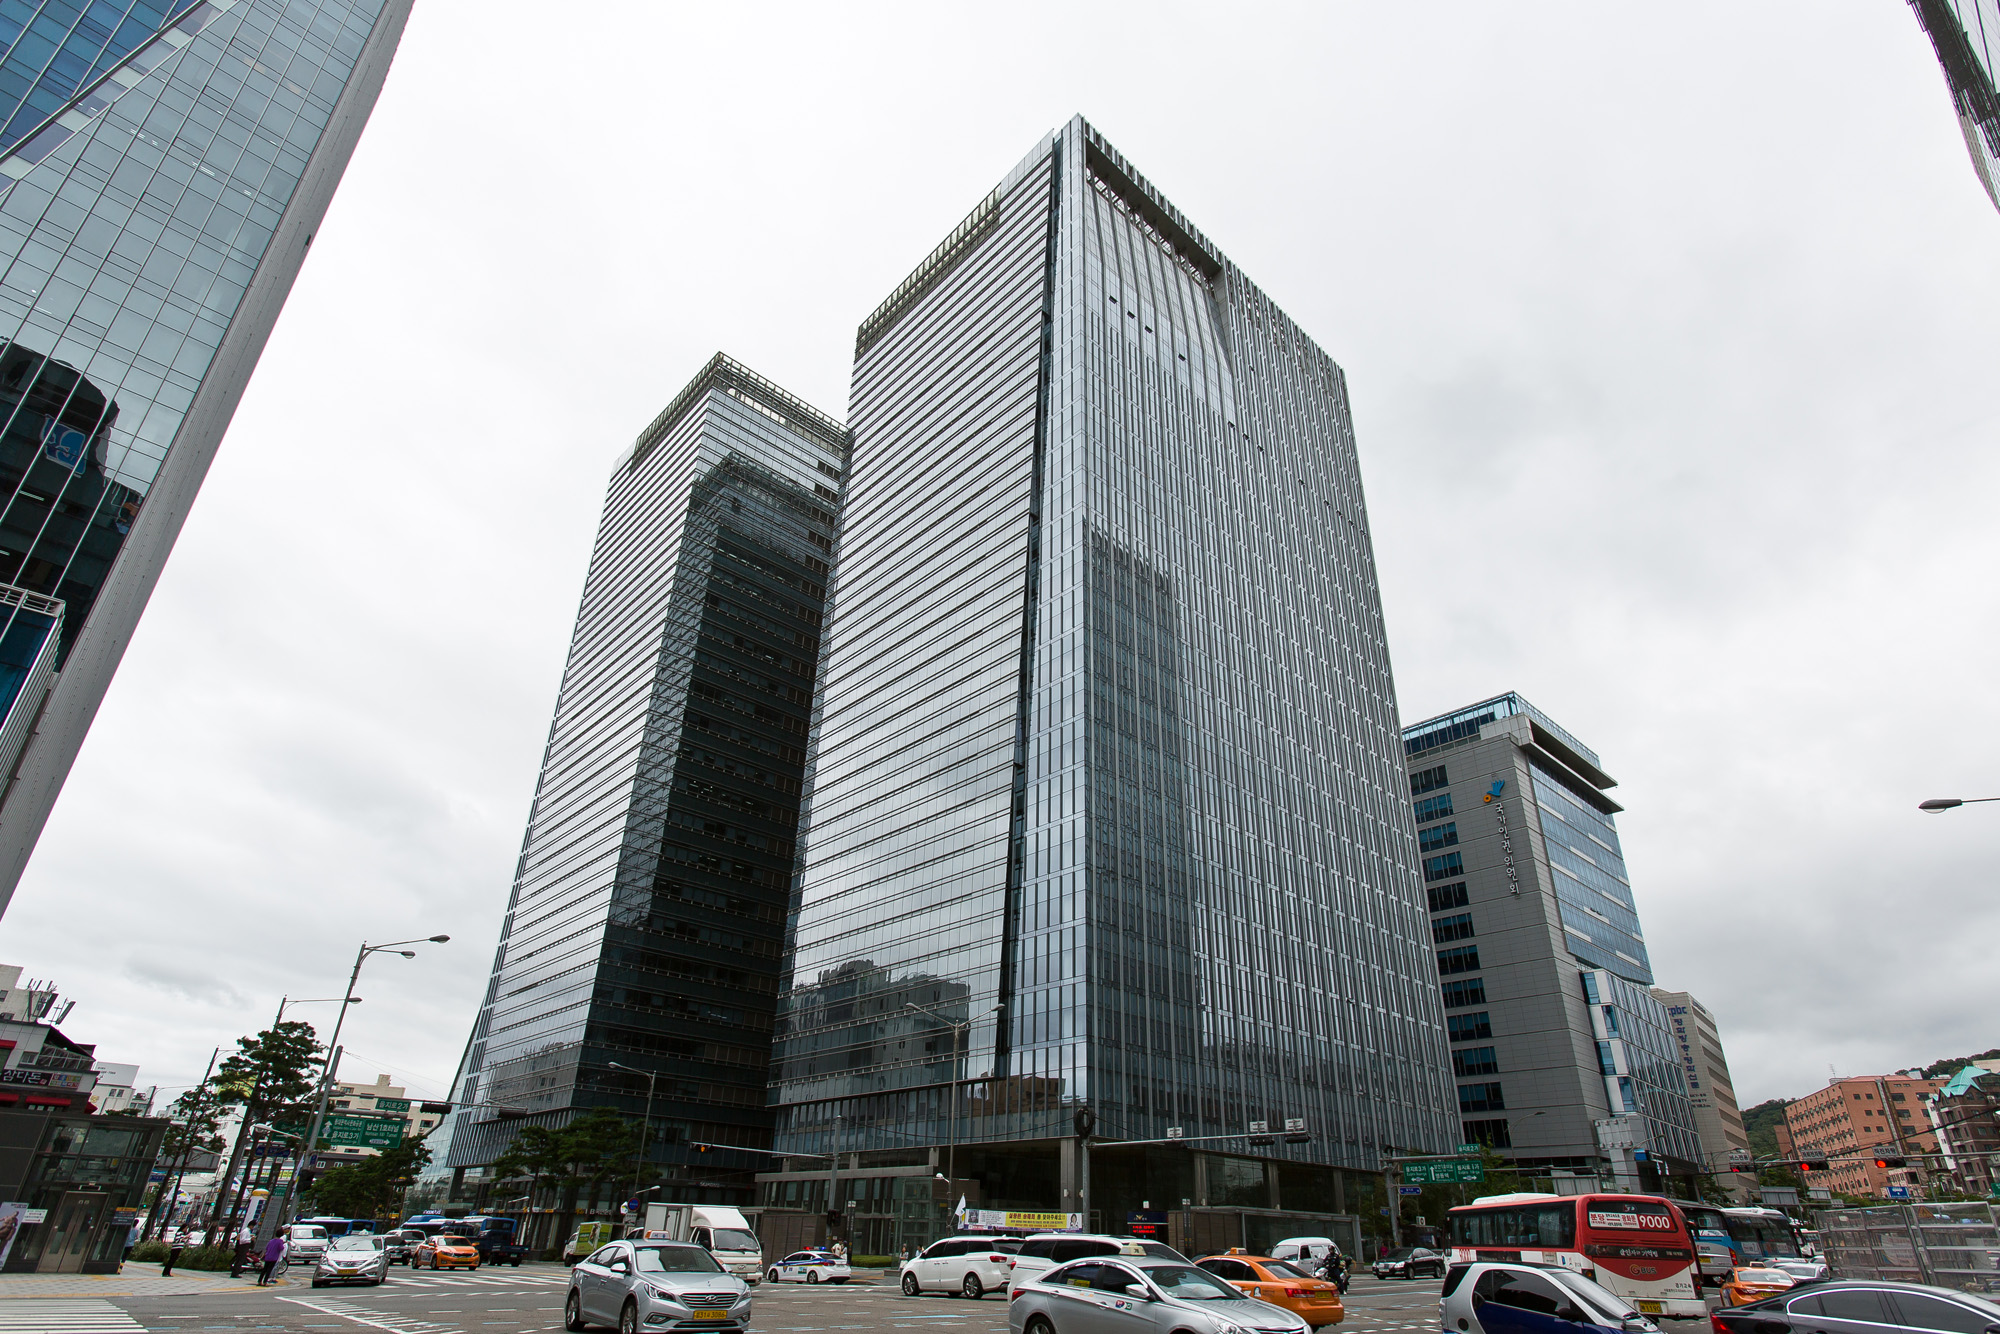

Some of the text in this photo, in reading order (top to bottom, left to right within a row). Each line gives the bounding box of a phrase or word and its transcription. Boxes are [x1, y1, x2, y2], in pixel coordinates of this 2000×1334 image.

[1496, 802, 1520, 894] 국가인권위원회
[379, 1101, 408, 1110] 을지로2가
[366, 1123, 399, 1132] 남산1호터널
[332, 1131, 359, 1140] 을지로3가
[1639, 1216, 1670, 1228] 9000
